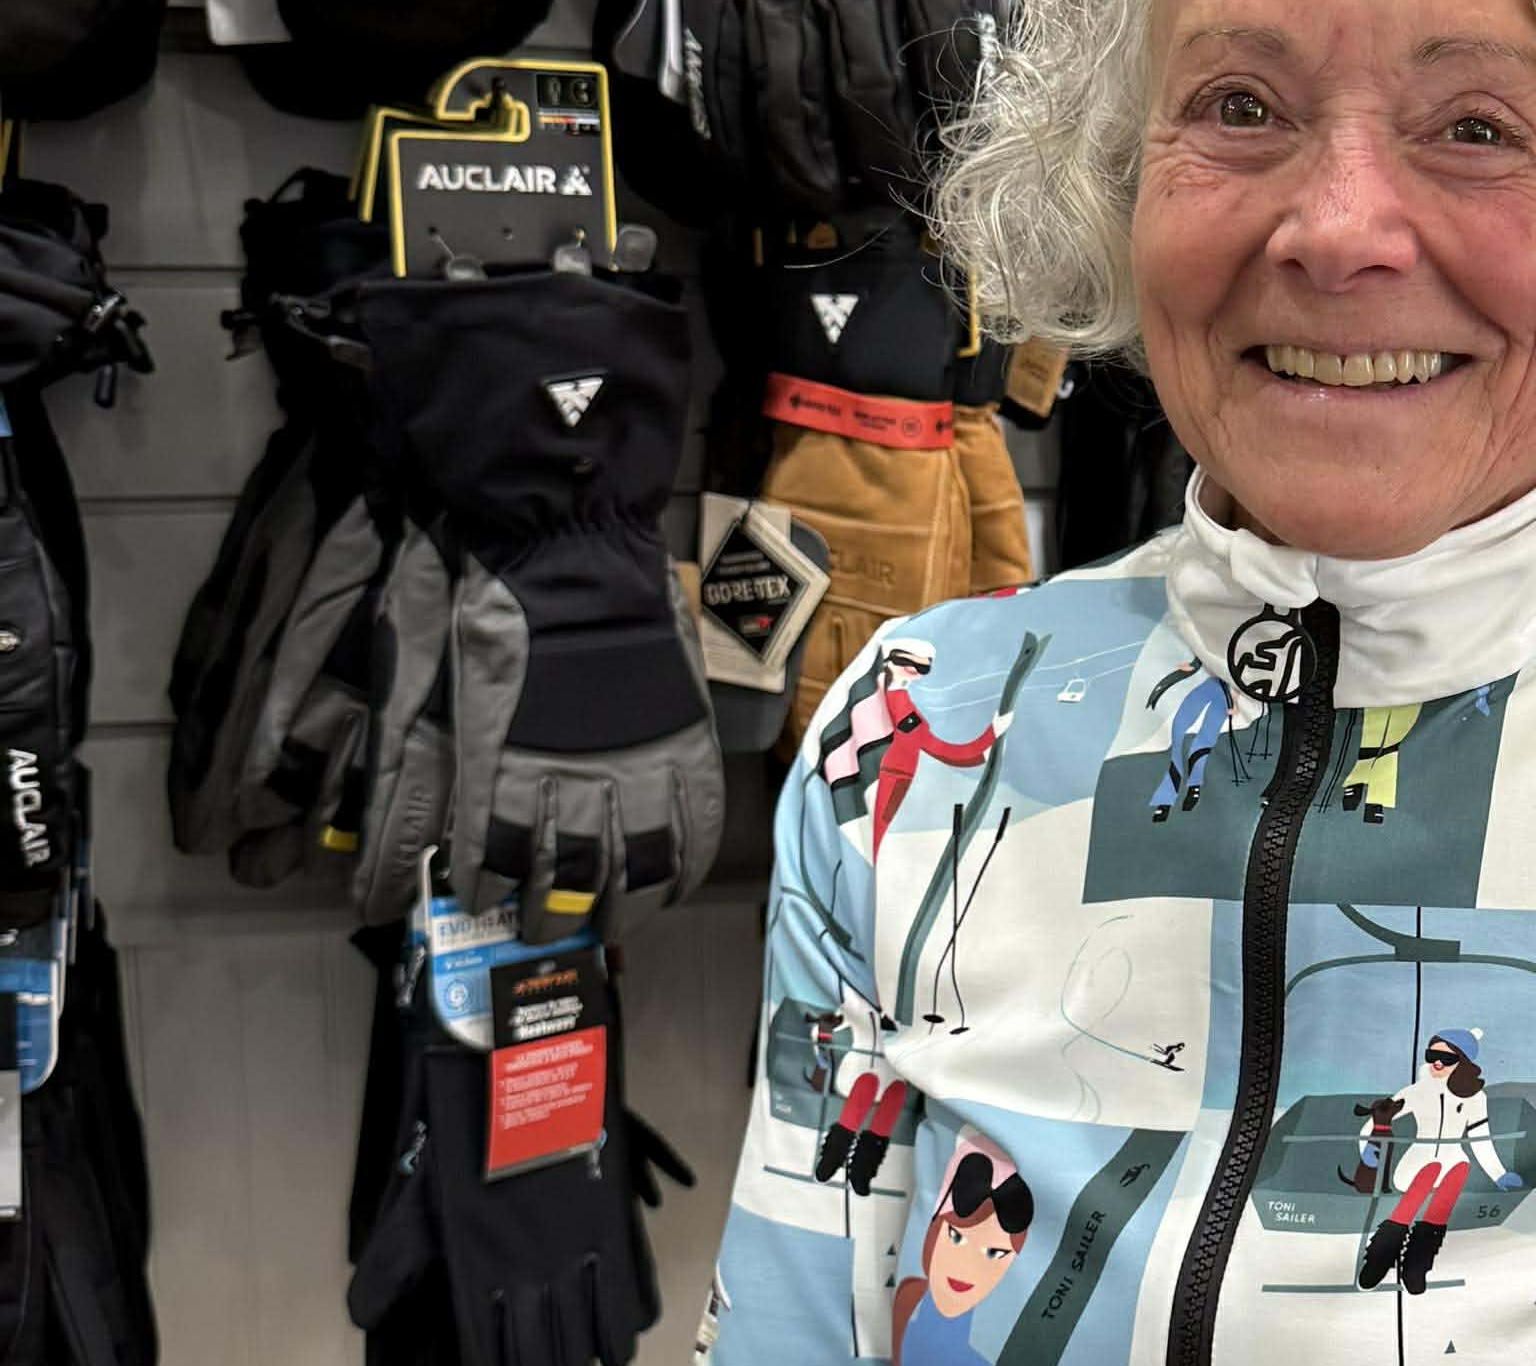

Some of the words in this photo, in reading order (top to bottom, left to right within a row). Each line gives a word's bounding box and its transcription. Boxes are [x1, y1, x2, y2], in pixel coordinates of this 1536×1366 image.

[417, 163, 558, 194] AUCLAIR
[704, 576, 791, 605] GORE-TEX
[8, 748, 51, 867] AUCLAIR
[1267, 1201, 1296, 1212] TONI
[1275, 1212, 1316, 1224] SAILER
[1477, 1205, 1501, 1219] 56
[1041, 1276, 1074, 1320] TONI
[1071, 1210, 1106, 1272] SAILER
